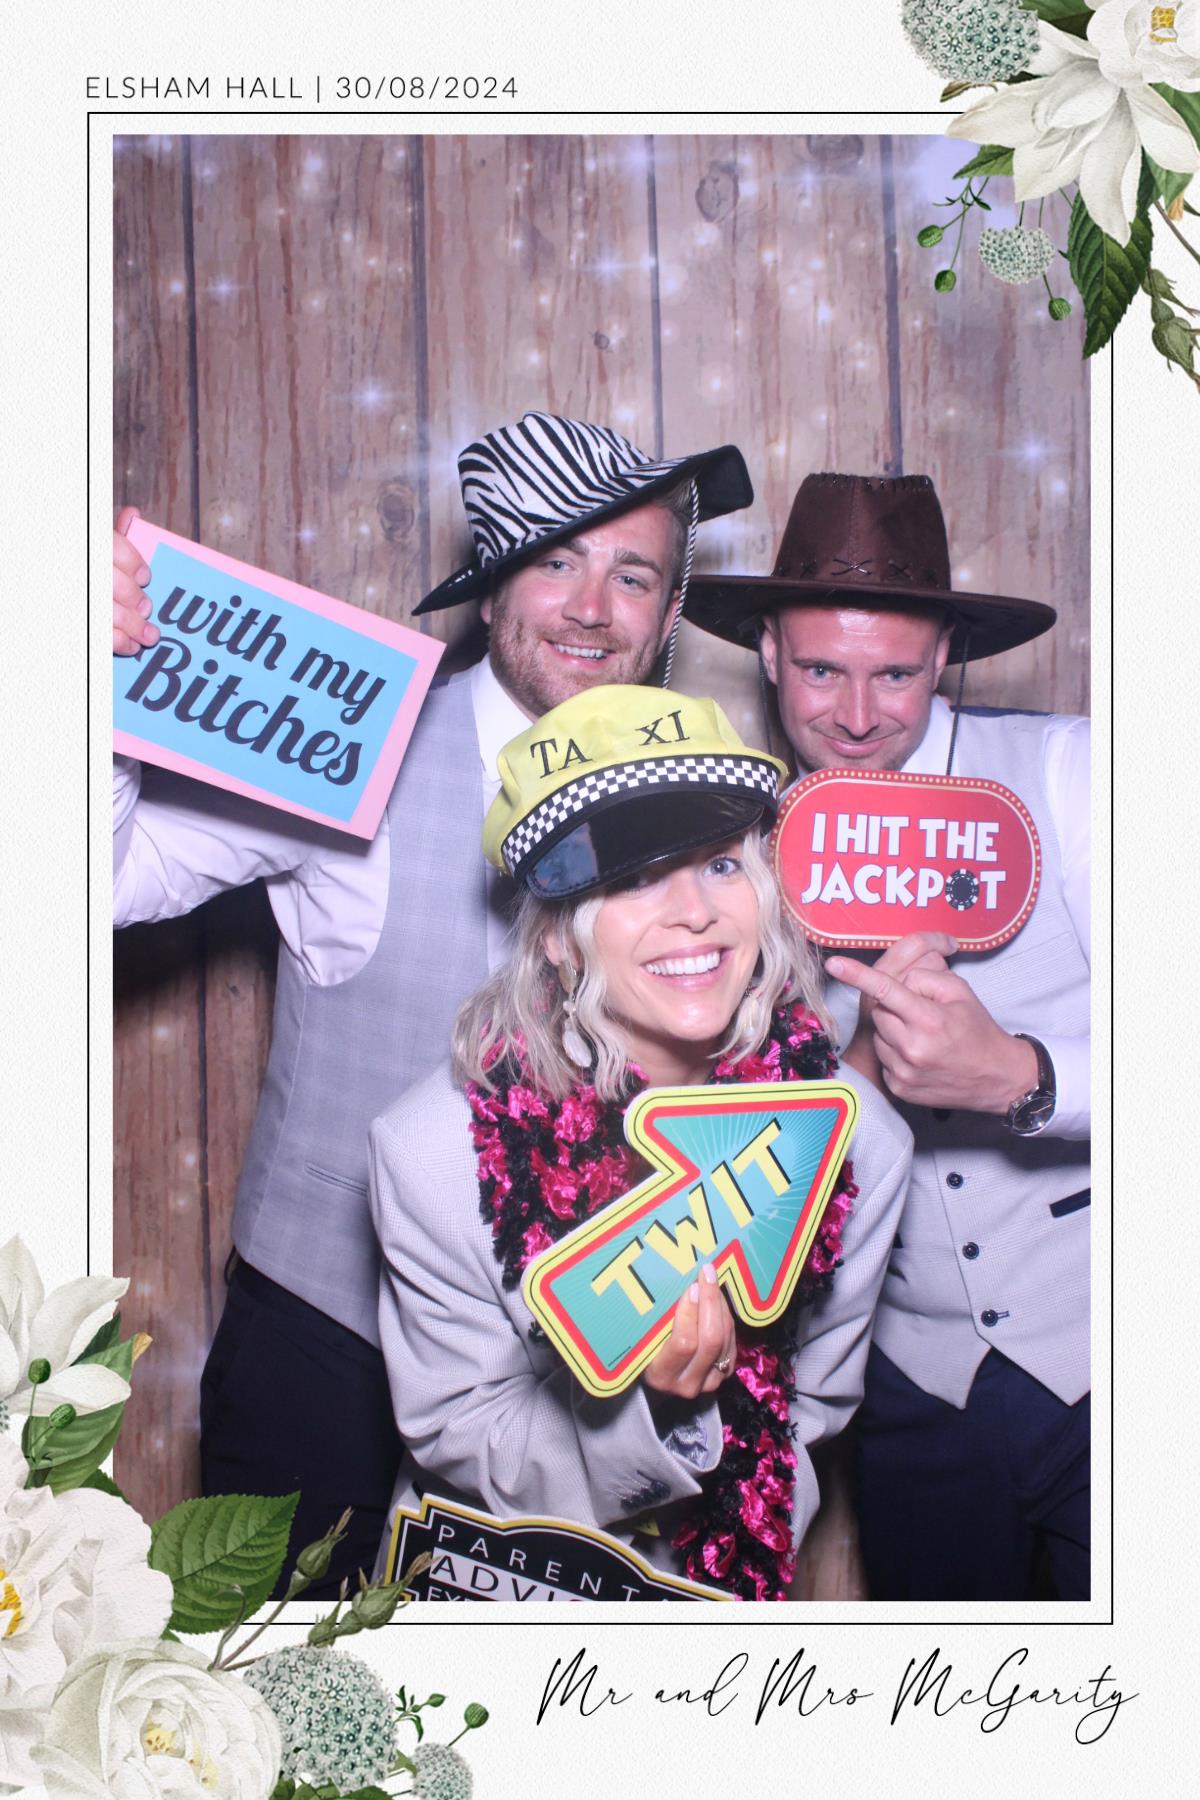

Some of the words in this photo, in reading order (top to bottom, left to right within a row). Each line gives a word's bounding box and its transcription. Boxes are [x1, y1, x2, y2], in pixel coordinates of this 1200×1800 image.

[157, 586, 287, 672] with
[290, 647, 387, 726] my
[124, 636, 363, 786] Bitches
[811, 812, 827, 853] I
[836, 813, 910, 857] HIT
[919, 818, 1000, 862] THE
[801, 861, 1007, 911] JACKPOT
[590, 1117, 792, 1316] TWIT
[431, 1555, 580, 1601] ADV
[437, 1523, 669, 1601] PARENT
